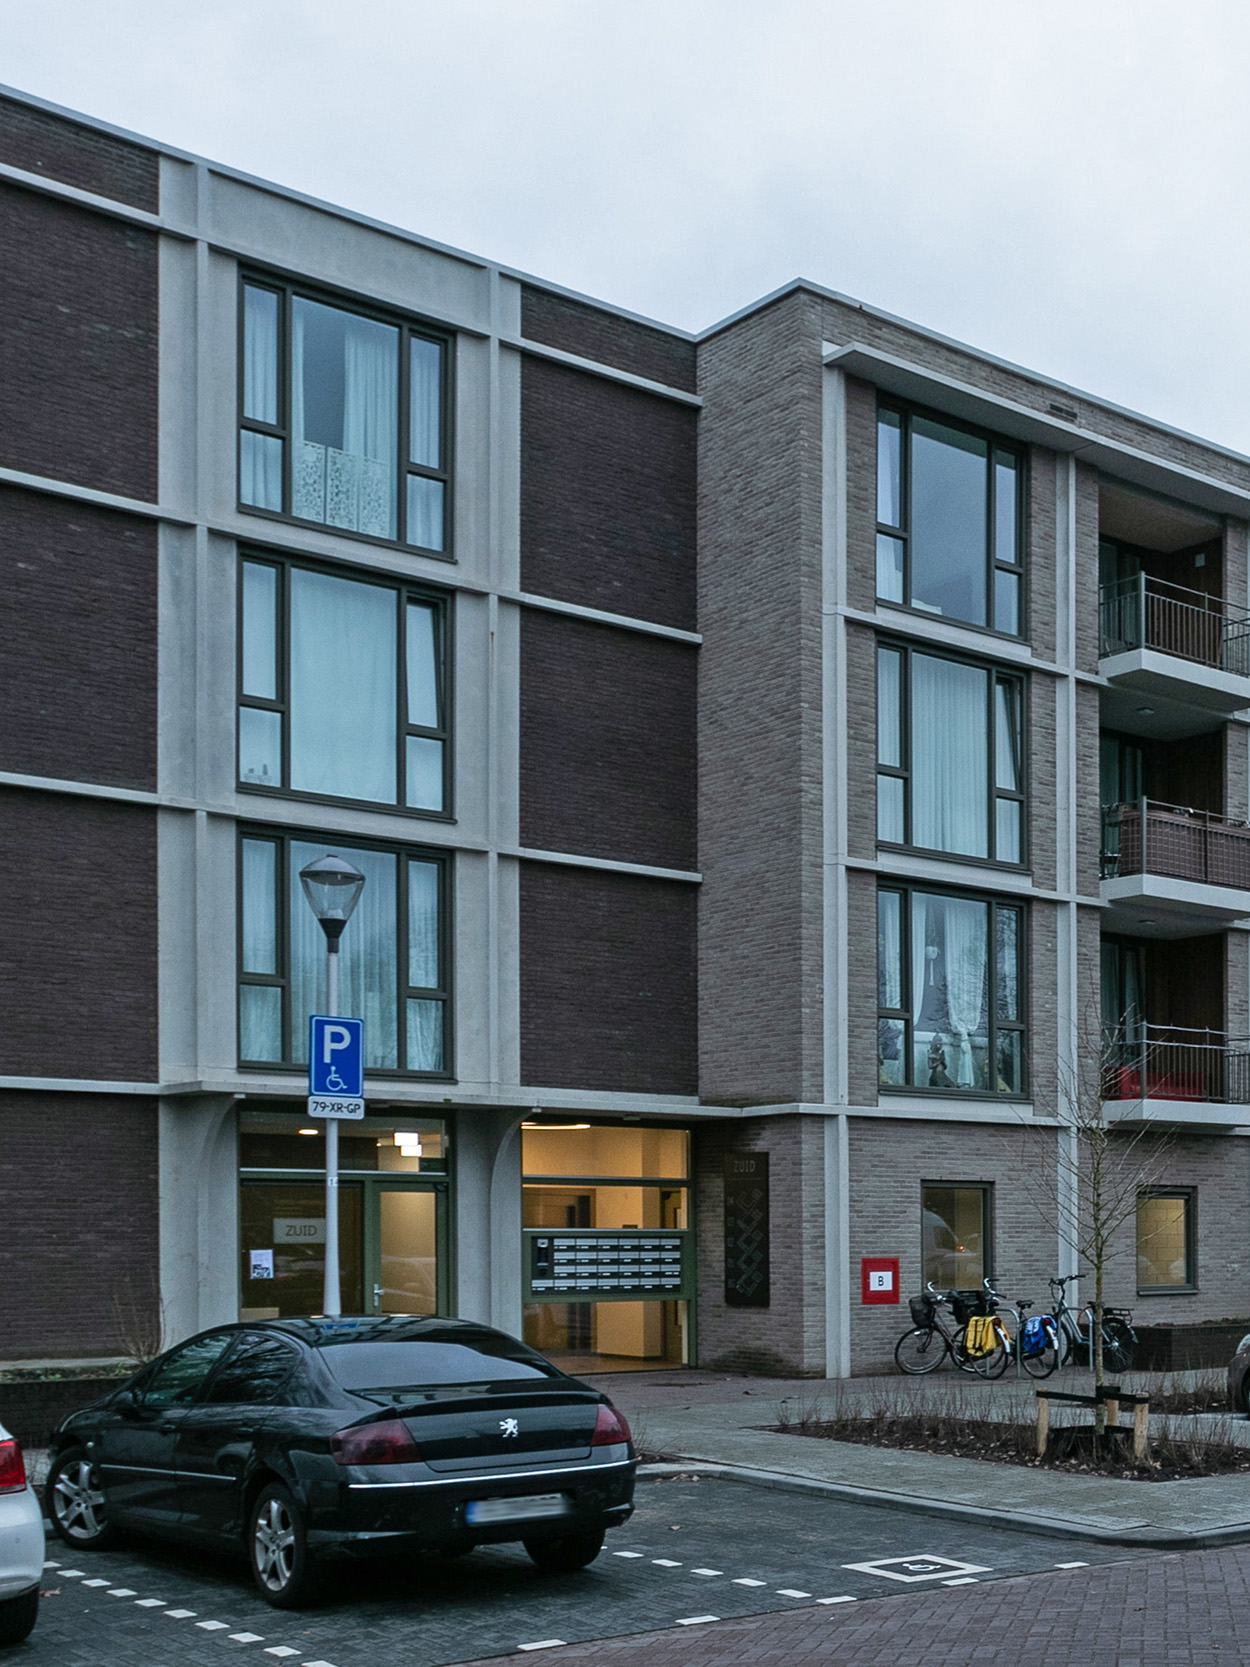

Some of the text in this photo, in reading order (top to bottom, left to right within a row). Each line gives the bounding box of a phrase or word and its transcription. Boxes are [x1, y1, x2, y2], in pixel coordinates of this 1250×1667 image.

[324, 1025, 351, 1064] P
[312, 1101, 361, 1114] 79-XR-GP
[733, 1160, 756, 1173] ZUID
[285, 1225, 318, 1237] ZUID
[878, 1276, 884, 1286] B
